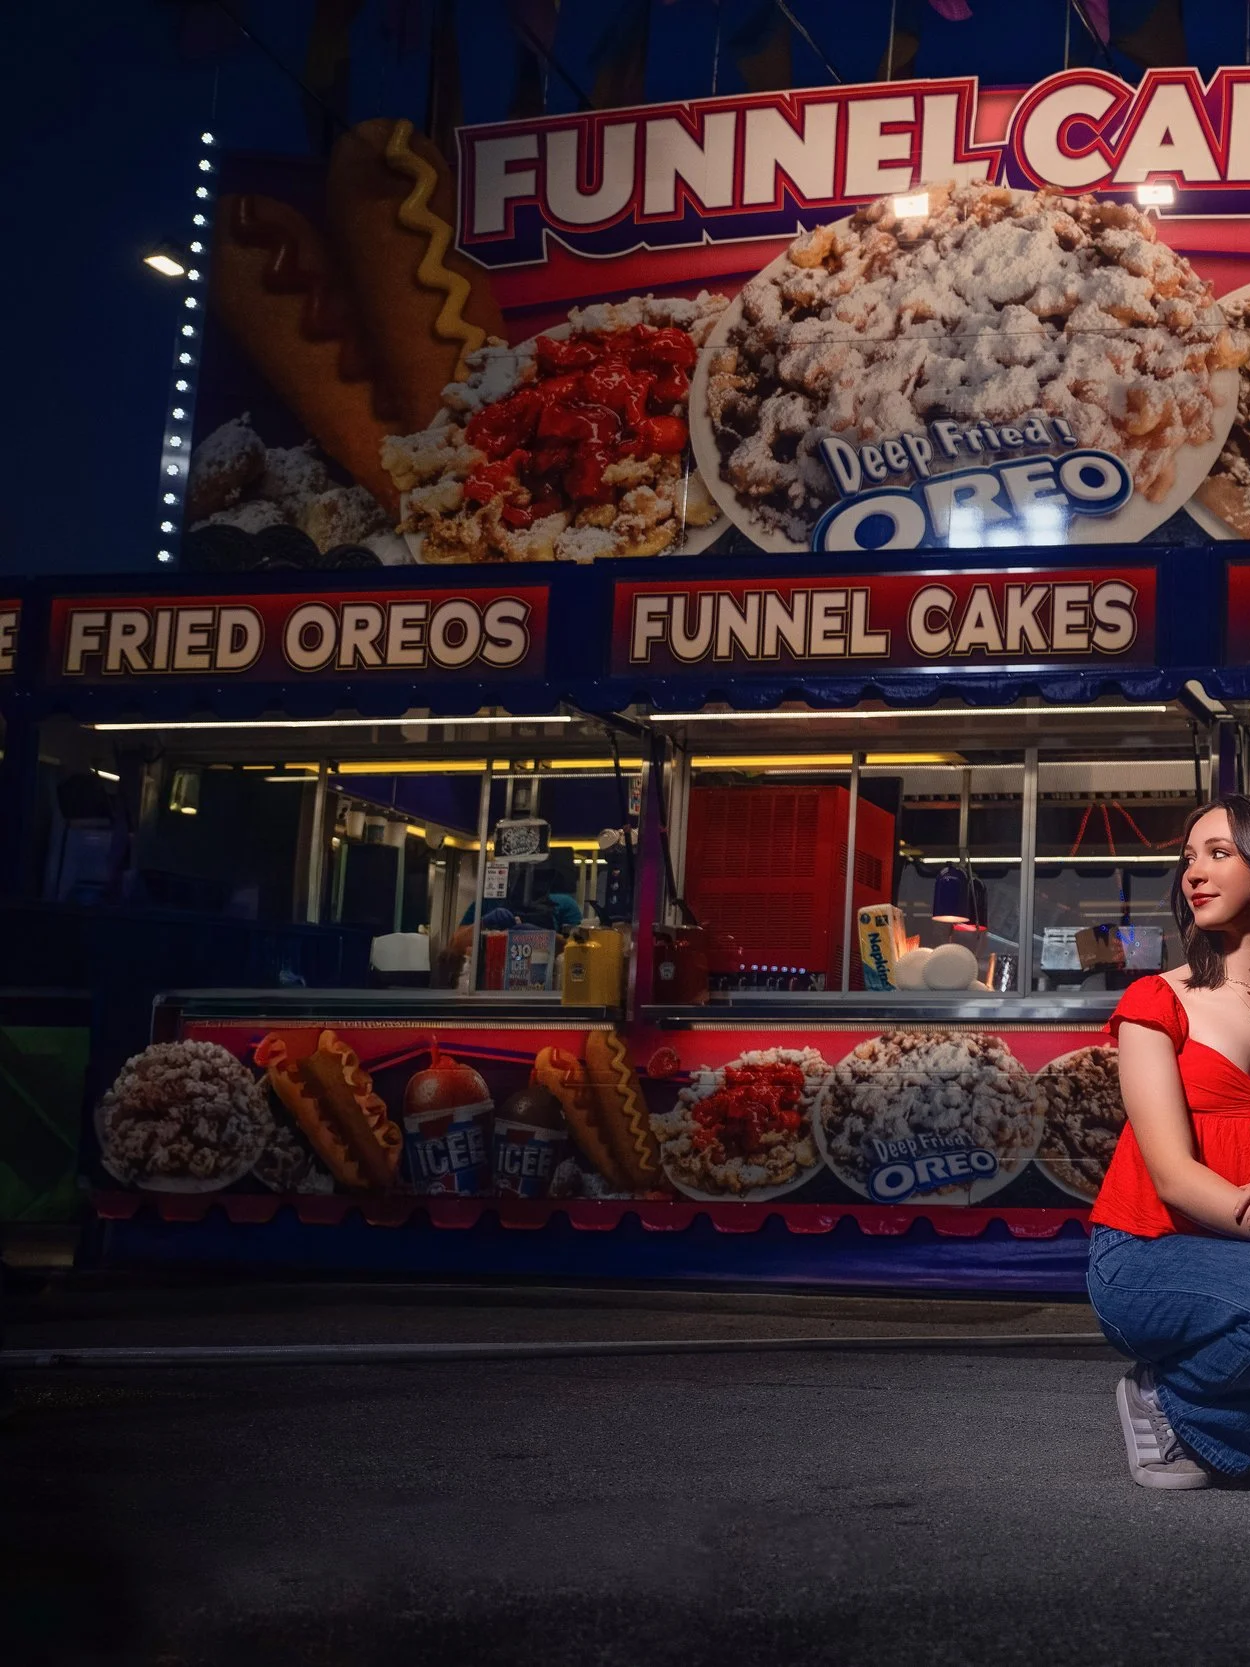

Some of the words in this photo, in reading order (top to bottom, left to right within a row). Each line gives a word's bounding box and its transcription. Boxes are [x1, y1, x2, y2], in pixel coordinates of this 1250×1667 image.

[472, 91, 993, 235] FUNNEL
[820, 432, 932, 497] Deep
[818, 452, 1128, 550] OREO
[64, 606, 263, 675] FRIED
[285, 598, 530, 669] OREOS
[631, 588, 891, 662] FUNNEL
[908, 581, 1137, 656] CAKES
[415, 1125, 487, 1177] ICEE
[872, 1138, 917, 1163] Deep
[872, 1150, 996, 1198] OREO
